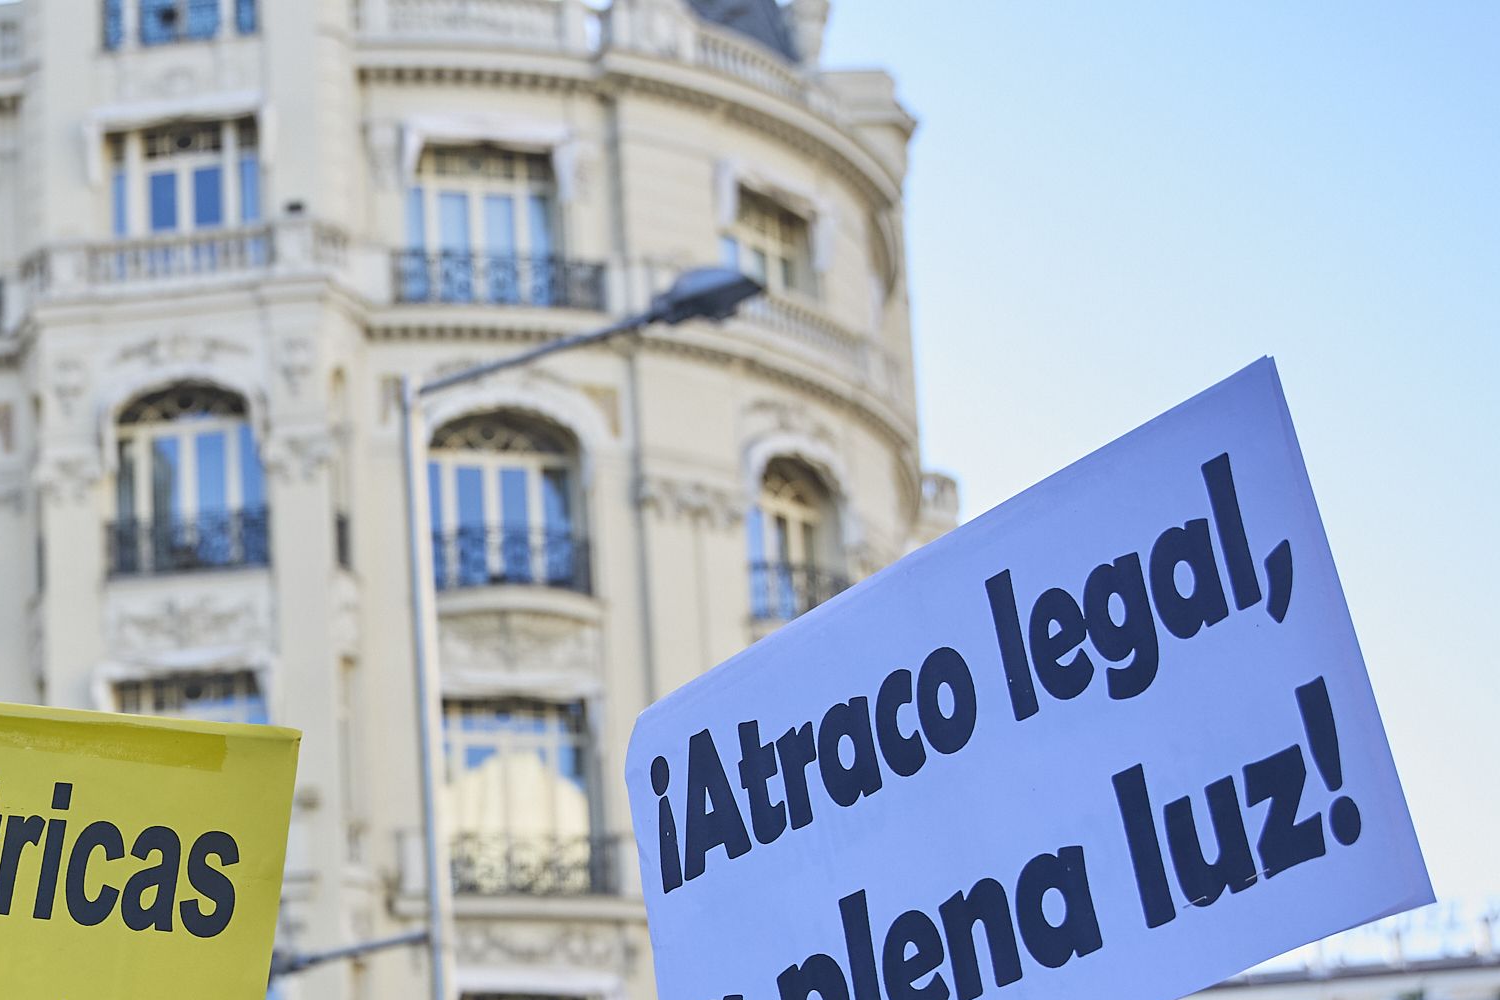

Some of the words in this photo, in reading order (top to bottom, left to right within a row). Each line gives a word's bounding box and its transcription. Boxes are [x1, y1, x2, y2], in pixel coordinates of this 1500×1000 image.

[650, 646, 979, 897] ¡Atraco
[984, 451, 1294, 723] legal,
[1111, 673, 1364, 931] luz!
